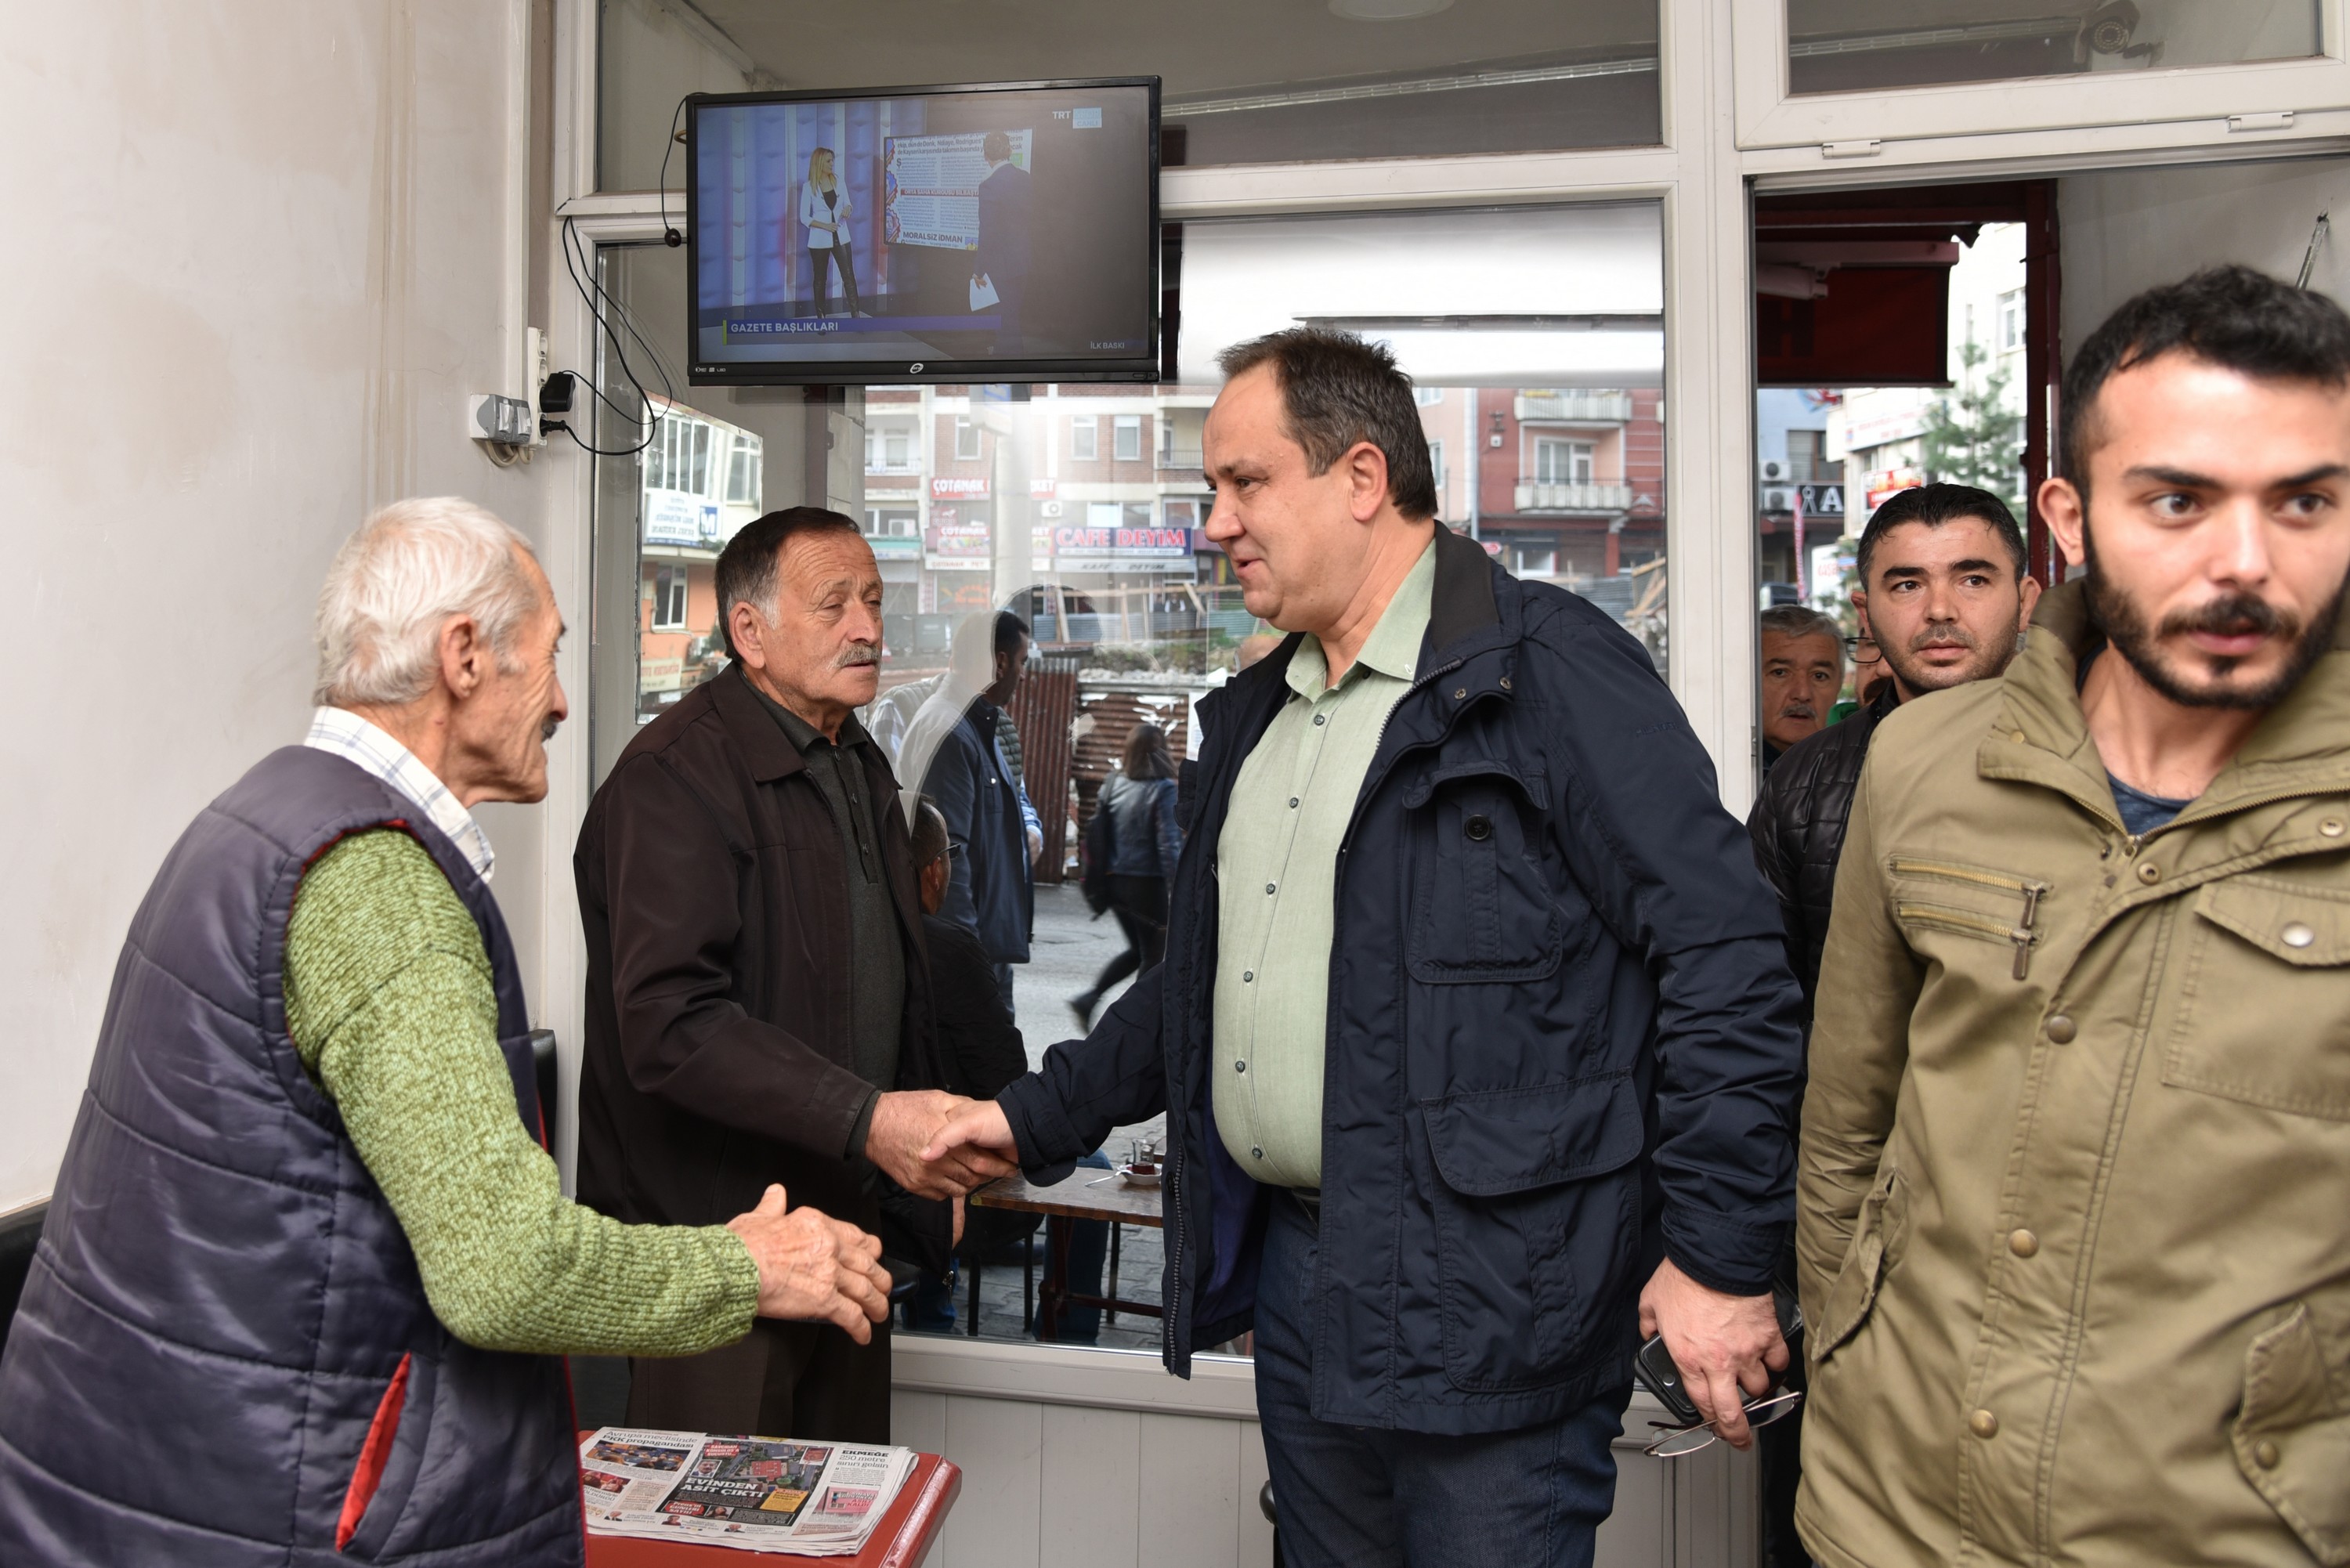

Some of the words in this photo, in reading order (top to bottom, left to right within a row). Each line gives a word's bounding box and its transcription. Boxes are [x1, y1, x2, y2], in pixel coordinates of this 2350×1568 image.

[1052, 110, 1072, 120] TRT
[902, 231, 938, 241] MORALSİZ
[938, 233, 963, 244] İDMAN
[731, 323, 772, 333] GAZETE
[776, 322, 838, 334] BAŞLIKLARI
[933, 478, 984, 496] ÇOTANAK
[1057, 528, 1110, 547] CAFE
[1116, 528, 1186, 547] DEYİM
[626, 1437, 694, 1448] propagandası
[646, 1434, 698, 1443] meclisinde
[686, 1477, 758, 1490] EVİNDEN
[720, 1489, 765, 1498] ÇIKTI
